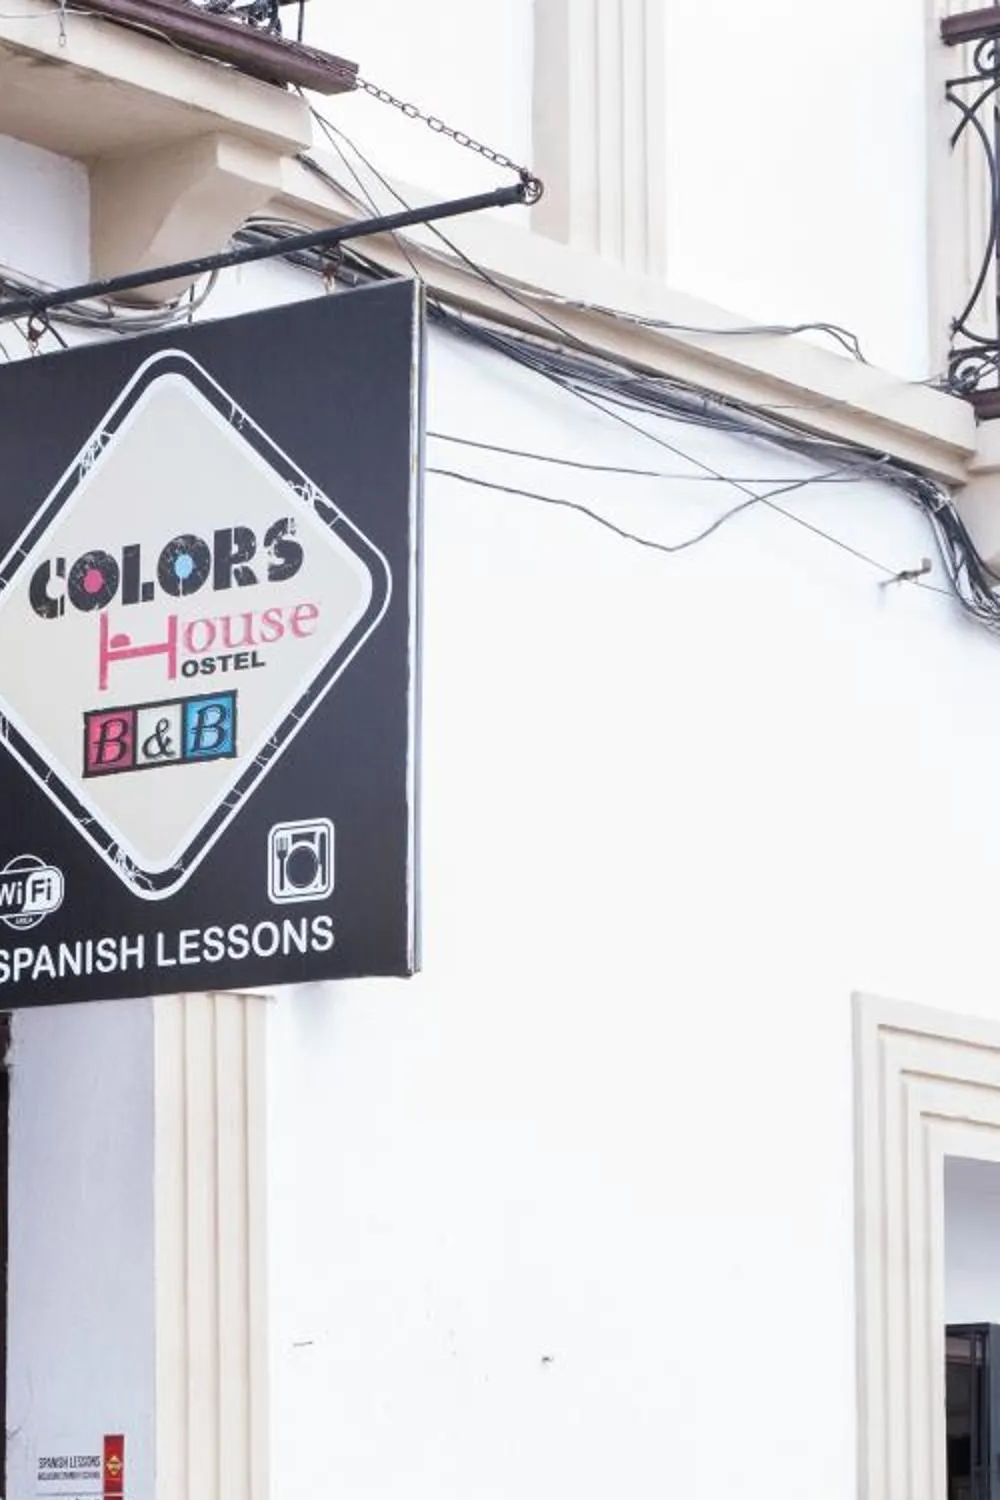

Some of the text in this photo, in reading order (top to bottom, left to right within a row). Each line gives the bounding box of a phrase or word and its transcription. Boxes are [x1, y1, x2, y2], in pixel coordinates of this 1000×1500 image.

[29, 517, 304, 619] COLORS
[98, 601, 320, 690] House
[157, 915, 335, 967] LESSONS
